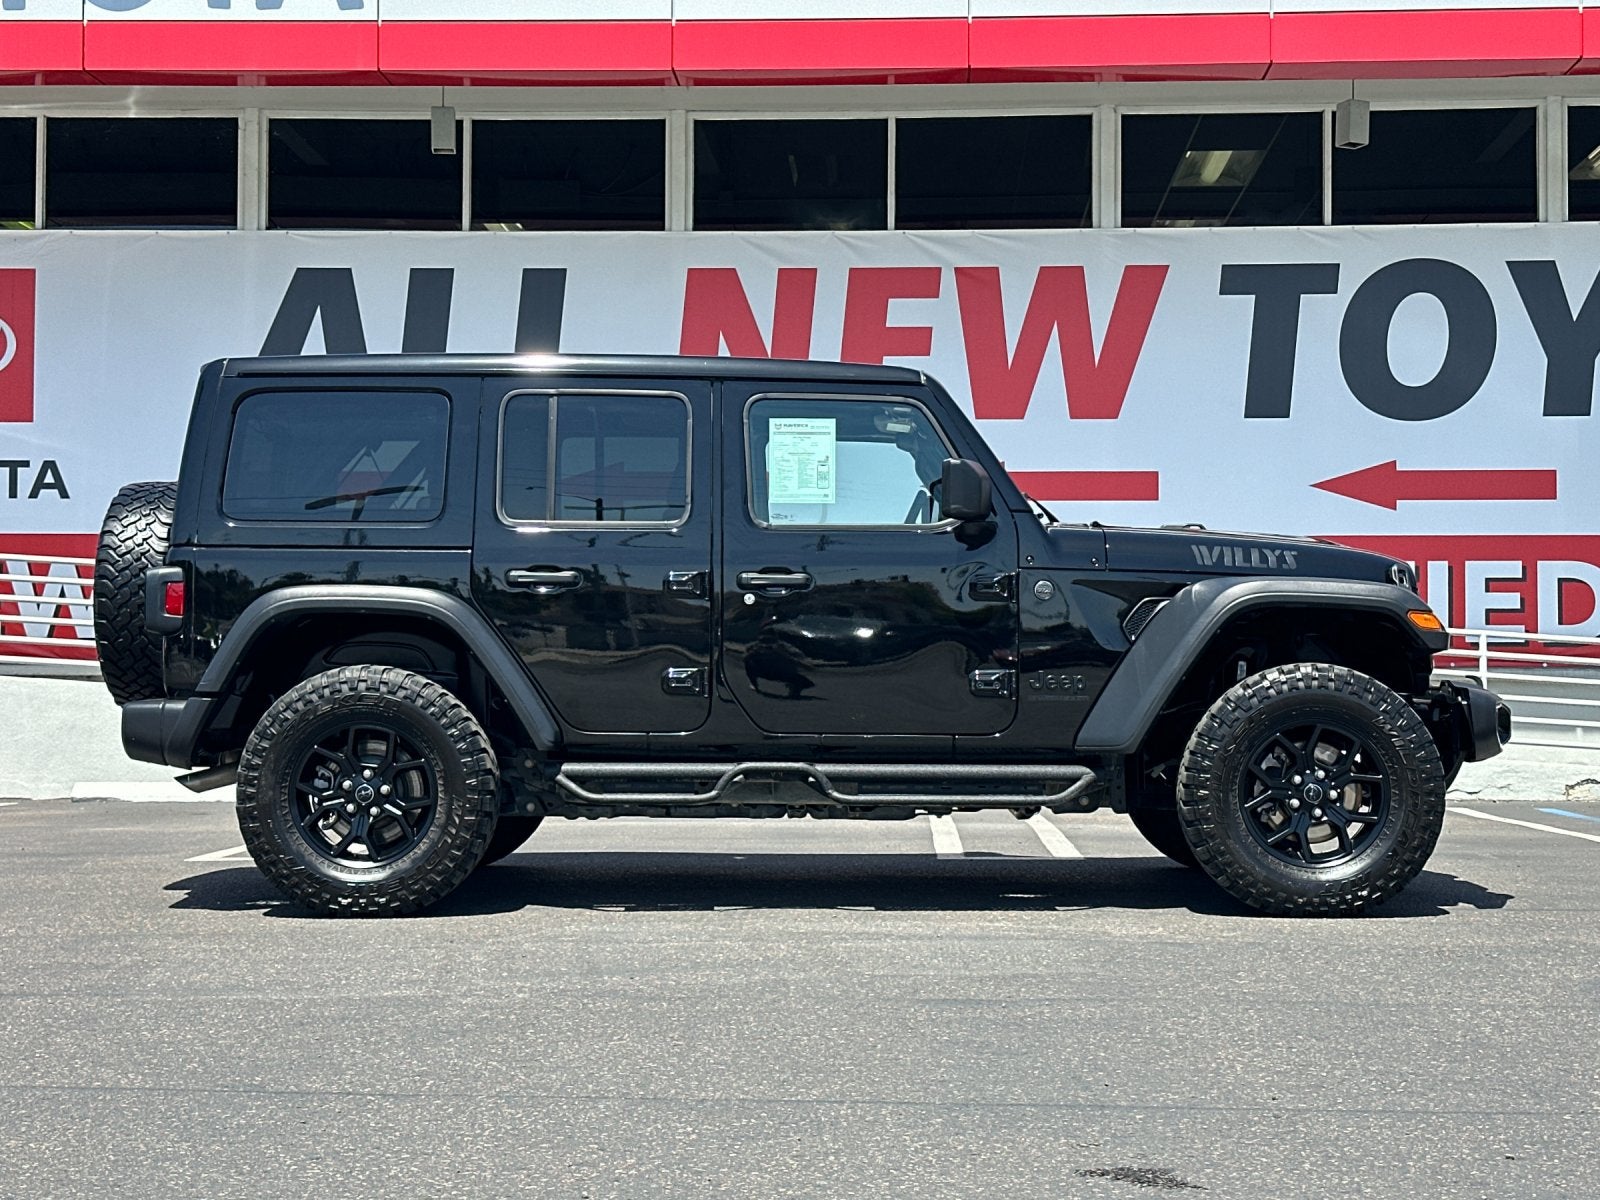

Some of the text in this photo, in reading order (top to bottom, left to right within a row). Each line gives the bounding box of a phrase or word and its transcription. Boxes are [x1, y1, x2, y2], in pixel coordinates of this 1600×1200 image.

[679, 265, 1170, 419] NEW
[1219, 257, 1600, 421] TOY
[0, 460, 70, 499] TA
[1190, 544, 1298, 570] WILLYS
[1408, 560, 1600, 643] IED
[1029, 670, 1087, 694] Jeep
